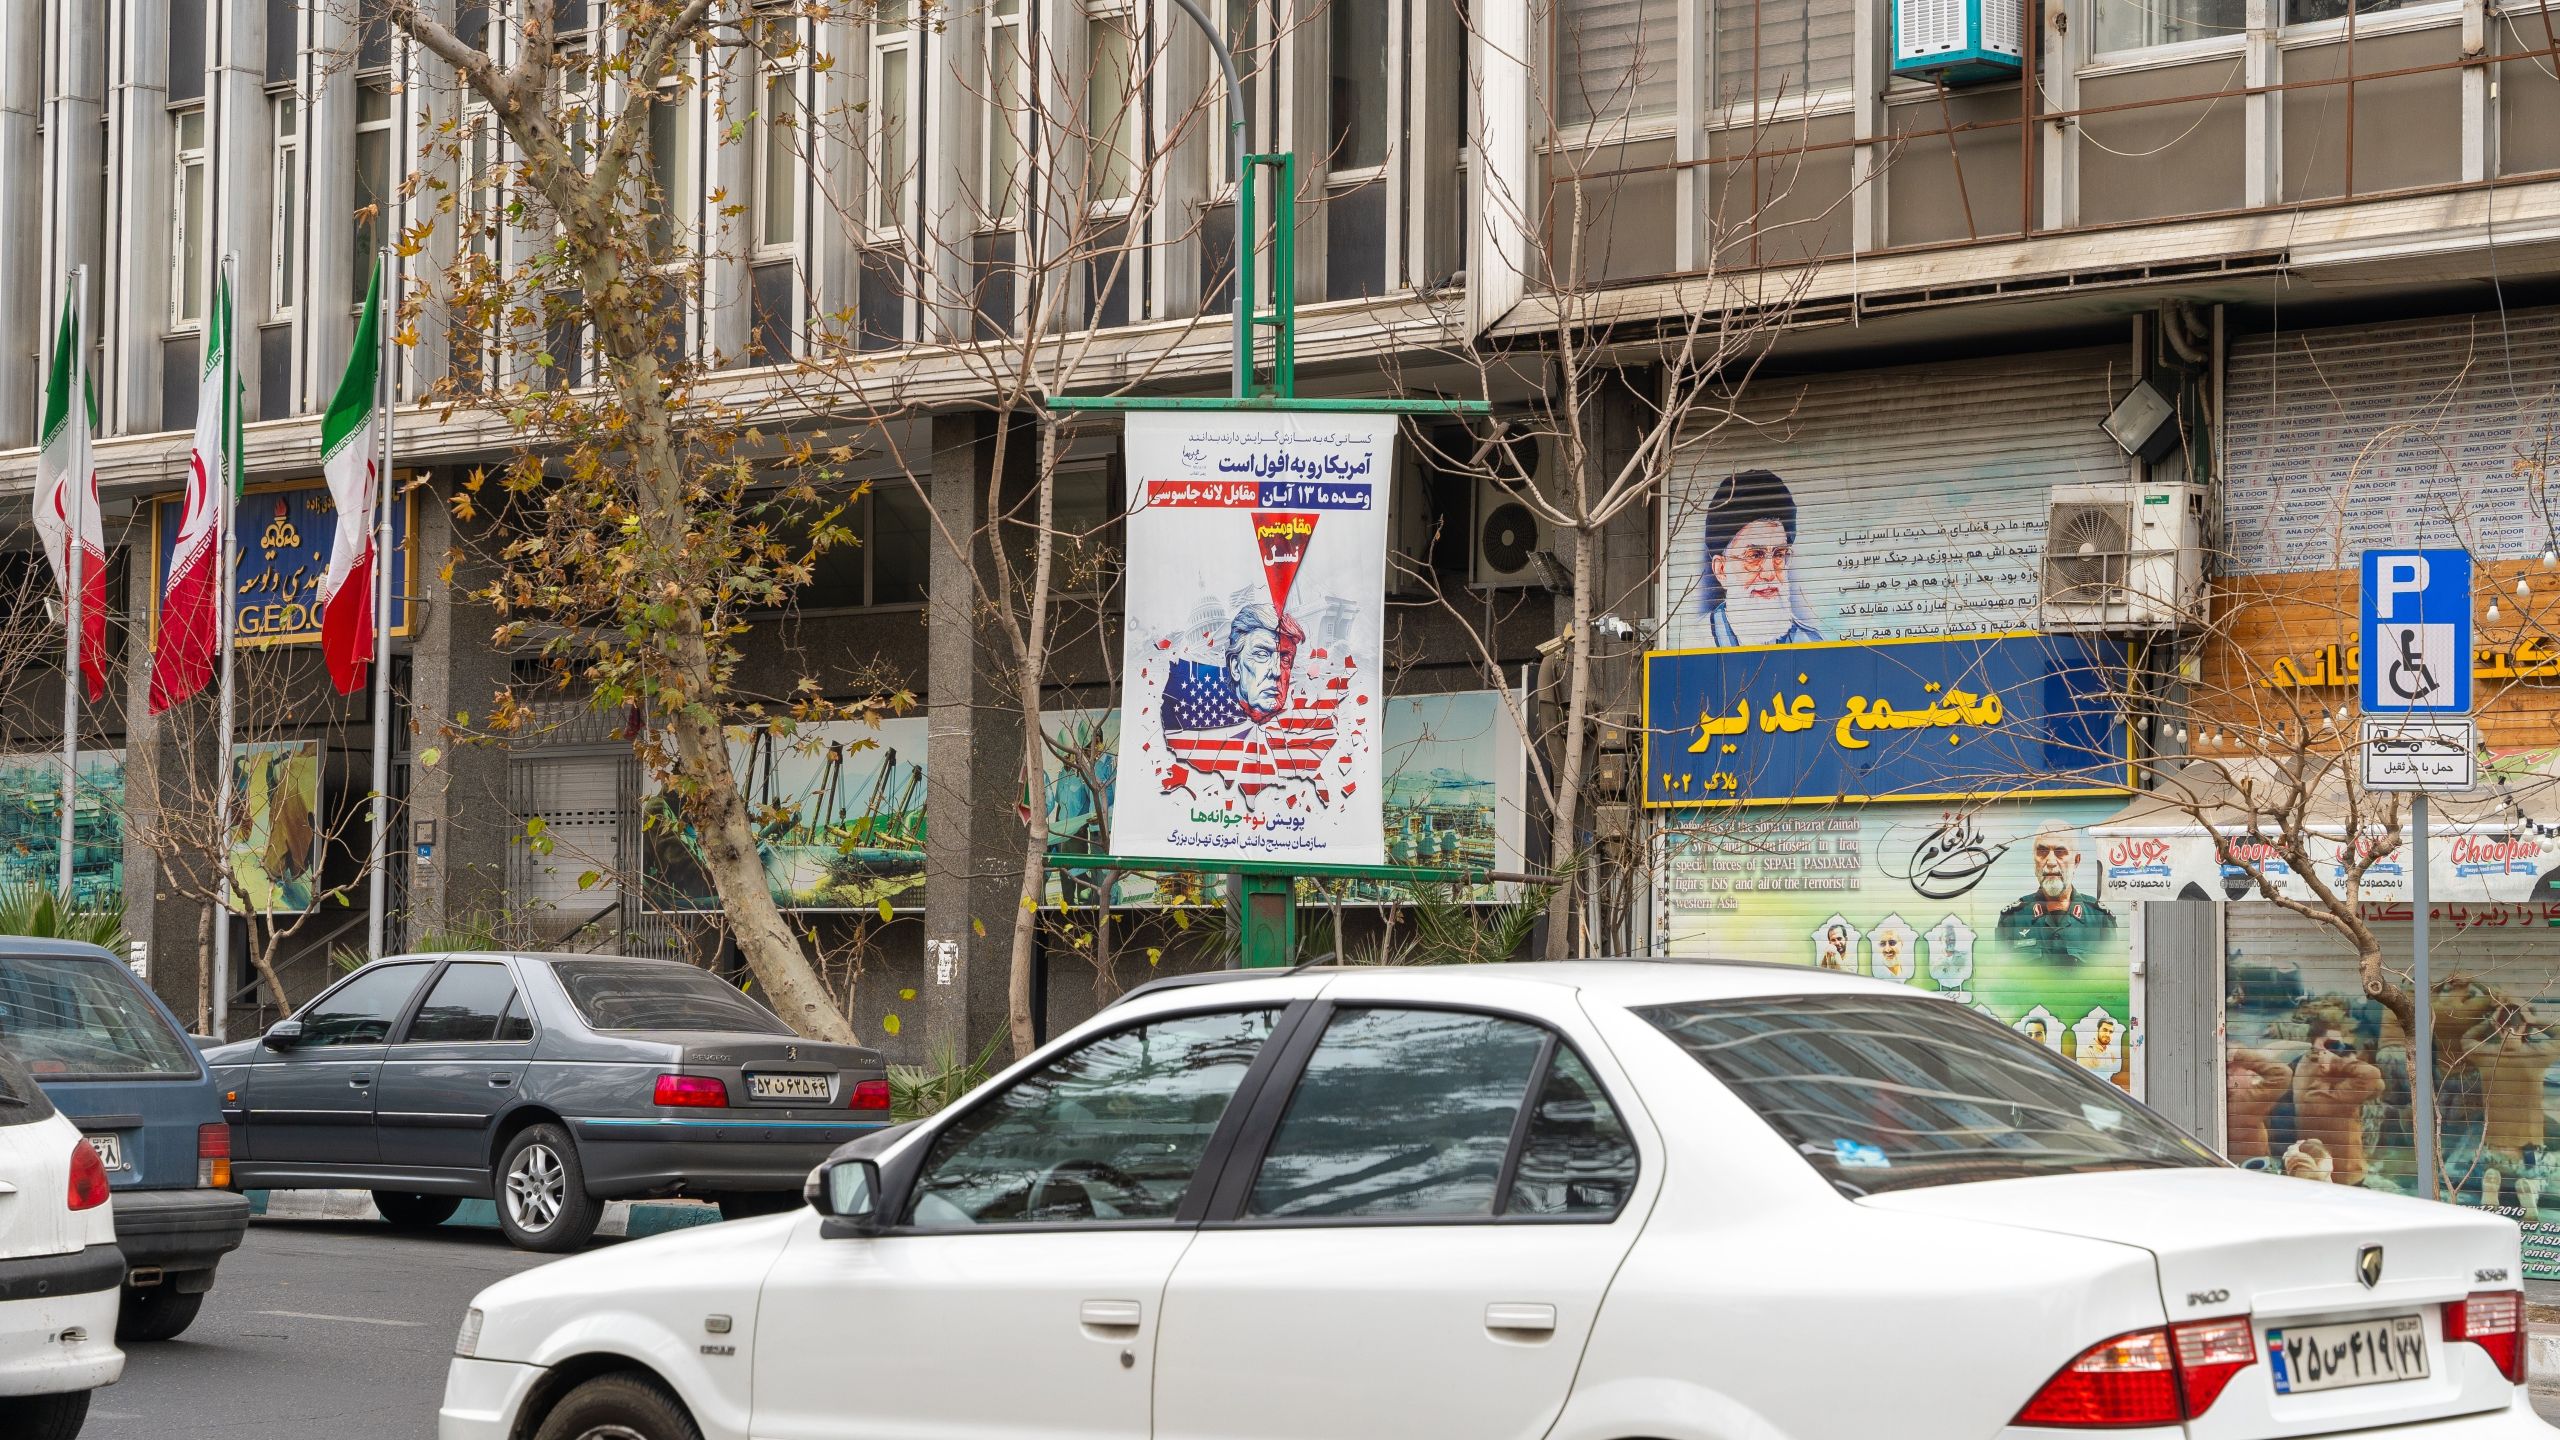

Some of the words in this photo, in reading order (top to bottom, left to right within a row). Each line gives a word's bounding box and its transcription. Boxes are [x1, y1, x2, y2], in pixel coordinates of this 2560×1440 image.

[1336, 433, 1372, 446] کسانی
[1218, 452, 1255, 473] است
[1255, 449, 1290, 478] افول
[1291, 457, 1306, 479] به
[1324, 452, 1373, 480] آمریکا
[1306, 462, 1323, 480] رو
[1149, 483, 1201, 505] جاسوسی
[1202, 483, 1223, 501] لانه
[1224, 484, 1256, 505] مقابل
[1262, 483, 1296, 507] آبان
[1298, 485, 1315, 503] ۱۳
[1317, 487, 1329, 503] ما
[1332, 491, 1370, 509] وعده
[1257, 517, 1312, 540] مقاومتیم
[2023, 520, 2050, 532] وییم؛
[1264, 545, 1299, 566] نسل
[1838, 556, 1860, 569] روزه
[1885, 551, 1907, 566] جنگ
[2021, 569, 2039, 583] وزه
[2377, 556, 2430, 618] P
[2018, 594, 2038, 607] ژیم
[1839, 604, 1856, 615] کند
[1687, 672, 1817, 754] غدیر
[1836, 681, 2004, 749] مجتمع
[2384, 762, 2419, 775] جرثقیل
[2422, 762, 2429, 774] با
[2431, 762, 2454, 775] حمل
[1662, 772, 1692, 793] ۲۰۲
[1703, 771, 1738, 797] پلاک
[1265, 813, 1305, 831] پویش
[1167, 830, 1188, 845] بزرگ
[1188, 832, 1212, 847] تهران
[1212, 832, 1239, 847] آموزی
[1240, 834, 1266, 849] دانش
[1266, 838, 1291, 852] بسیج
[1292, 836, 1327, 850] سازمان
[1819, 837, 1829, 851] in
[2109, 836, 2171, 868] چوپان
[2451, 833, 2541, 876] Choopan
[1676, 858, 1707, 872] special
[1712, 857, 1741, 871] forces
[1746, 857, 1757, 871] of
[1764, 857, 1796, 870] SEPAH
[1804, 856, 1861, 869] PASDARAN
[1711, 877, 1728, 890] ISIS
[1735, 877, 1753, 890] and
[1758, 877, 1769, 890] all
[1771, 877, 1783, 890] of
[1784, 876, 1799, 889] the
[1802, 876, 1845, 889] Terrorist
[1850, 876, 1860, 888] in
[1675, 897, 1712, 909] western
[1716, 896, 1738, 908] Asia
[811, 1082, 826, 1096] ۴۴
[2520, 1220, 2540, 1231] ted
[2541, 1223, 2560, 1233] Sta
[2529, 1235, 2560, 1247] PASD
[2524, 1248, 2557, 1260] enter
